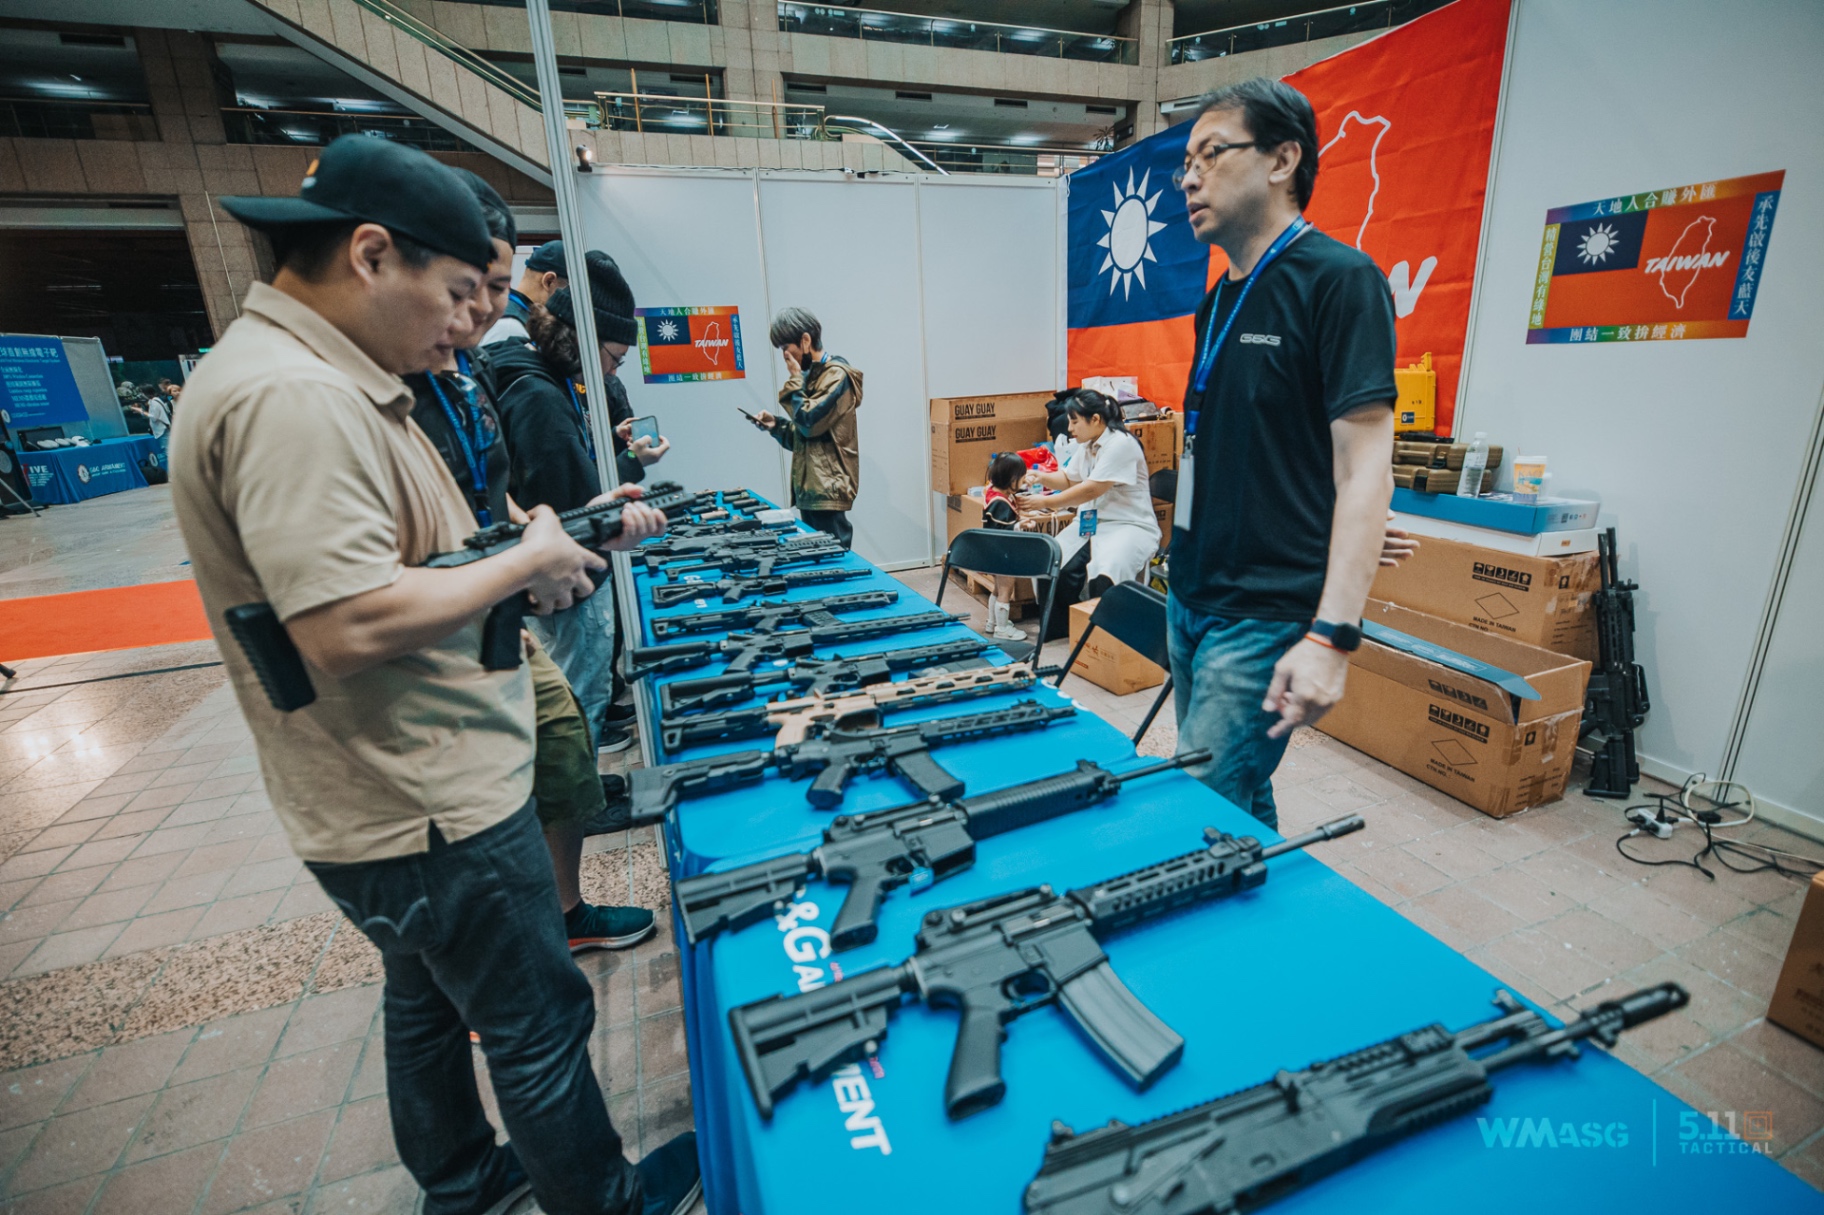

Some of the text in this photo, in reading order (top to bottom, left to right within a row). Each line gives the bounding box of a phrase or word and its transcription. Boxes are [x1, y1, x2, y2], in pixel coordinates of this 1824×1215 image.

[1593, 182, 1718, 216] 天地人合賺外匯
[1644, 251, 1731, 274] TAIWAN
[694, 339, 729, 348] TAIWAN
[1240, 333, 1282, 347] G&G
[955, 402, 995, 416] GUAY GUAY
[955, 425, 996, 439] GUAY GUAY
[1473, 616, 1488, 626] MADE
[1496, 622, 1517, 633] TAIWAN
[1430, 758, 1476, 783] MADE IN TAIWAN
